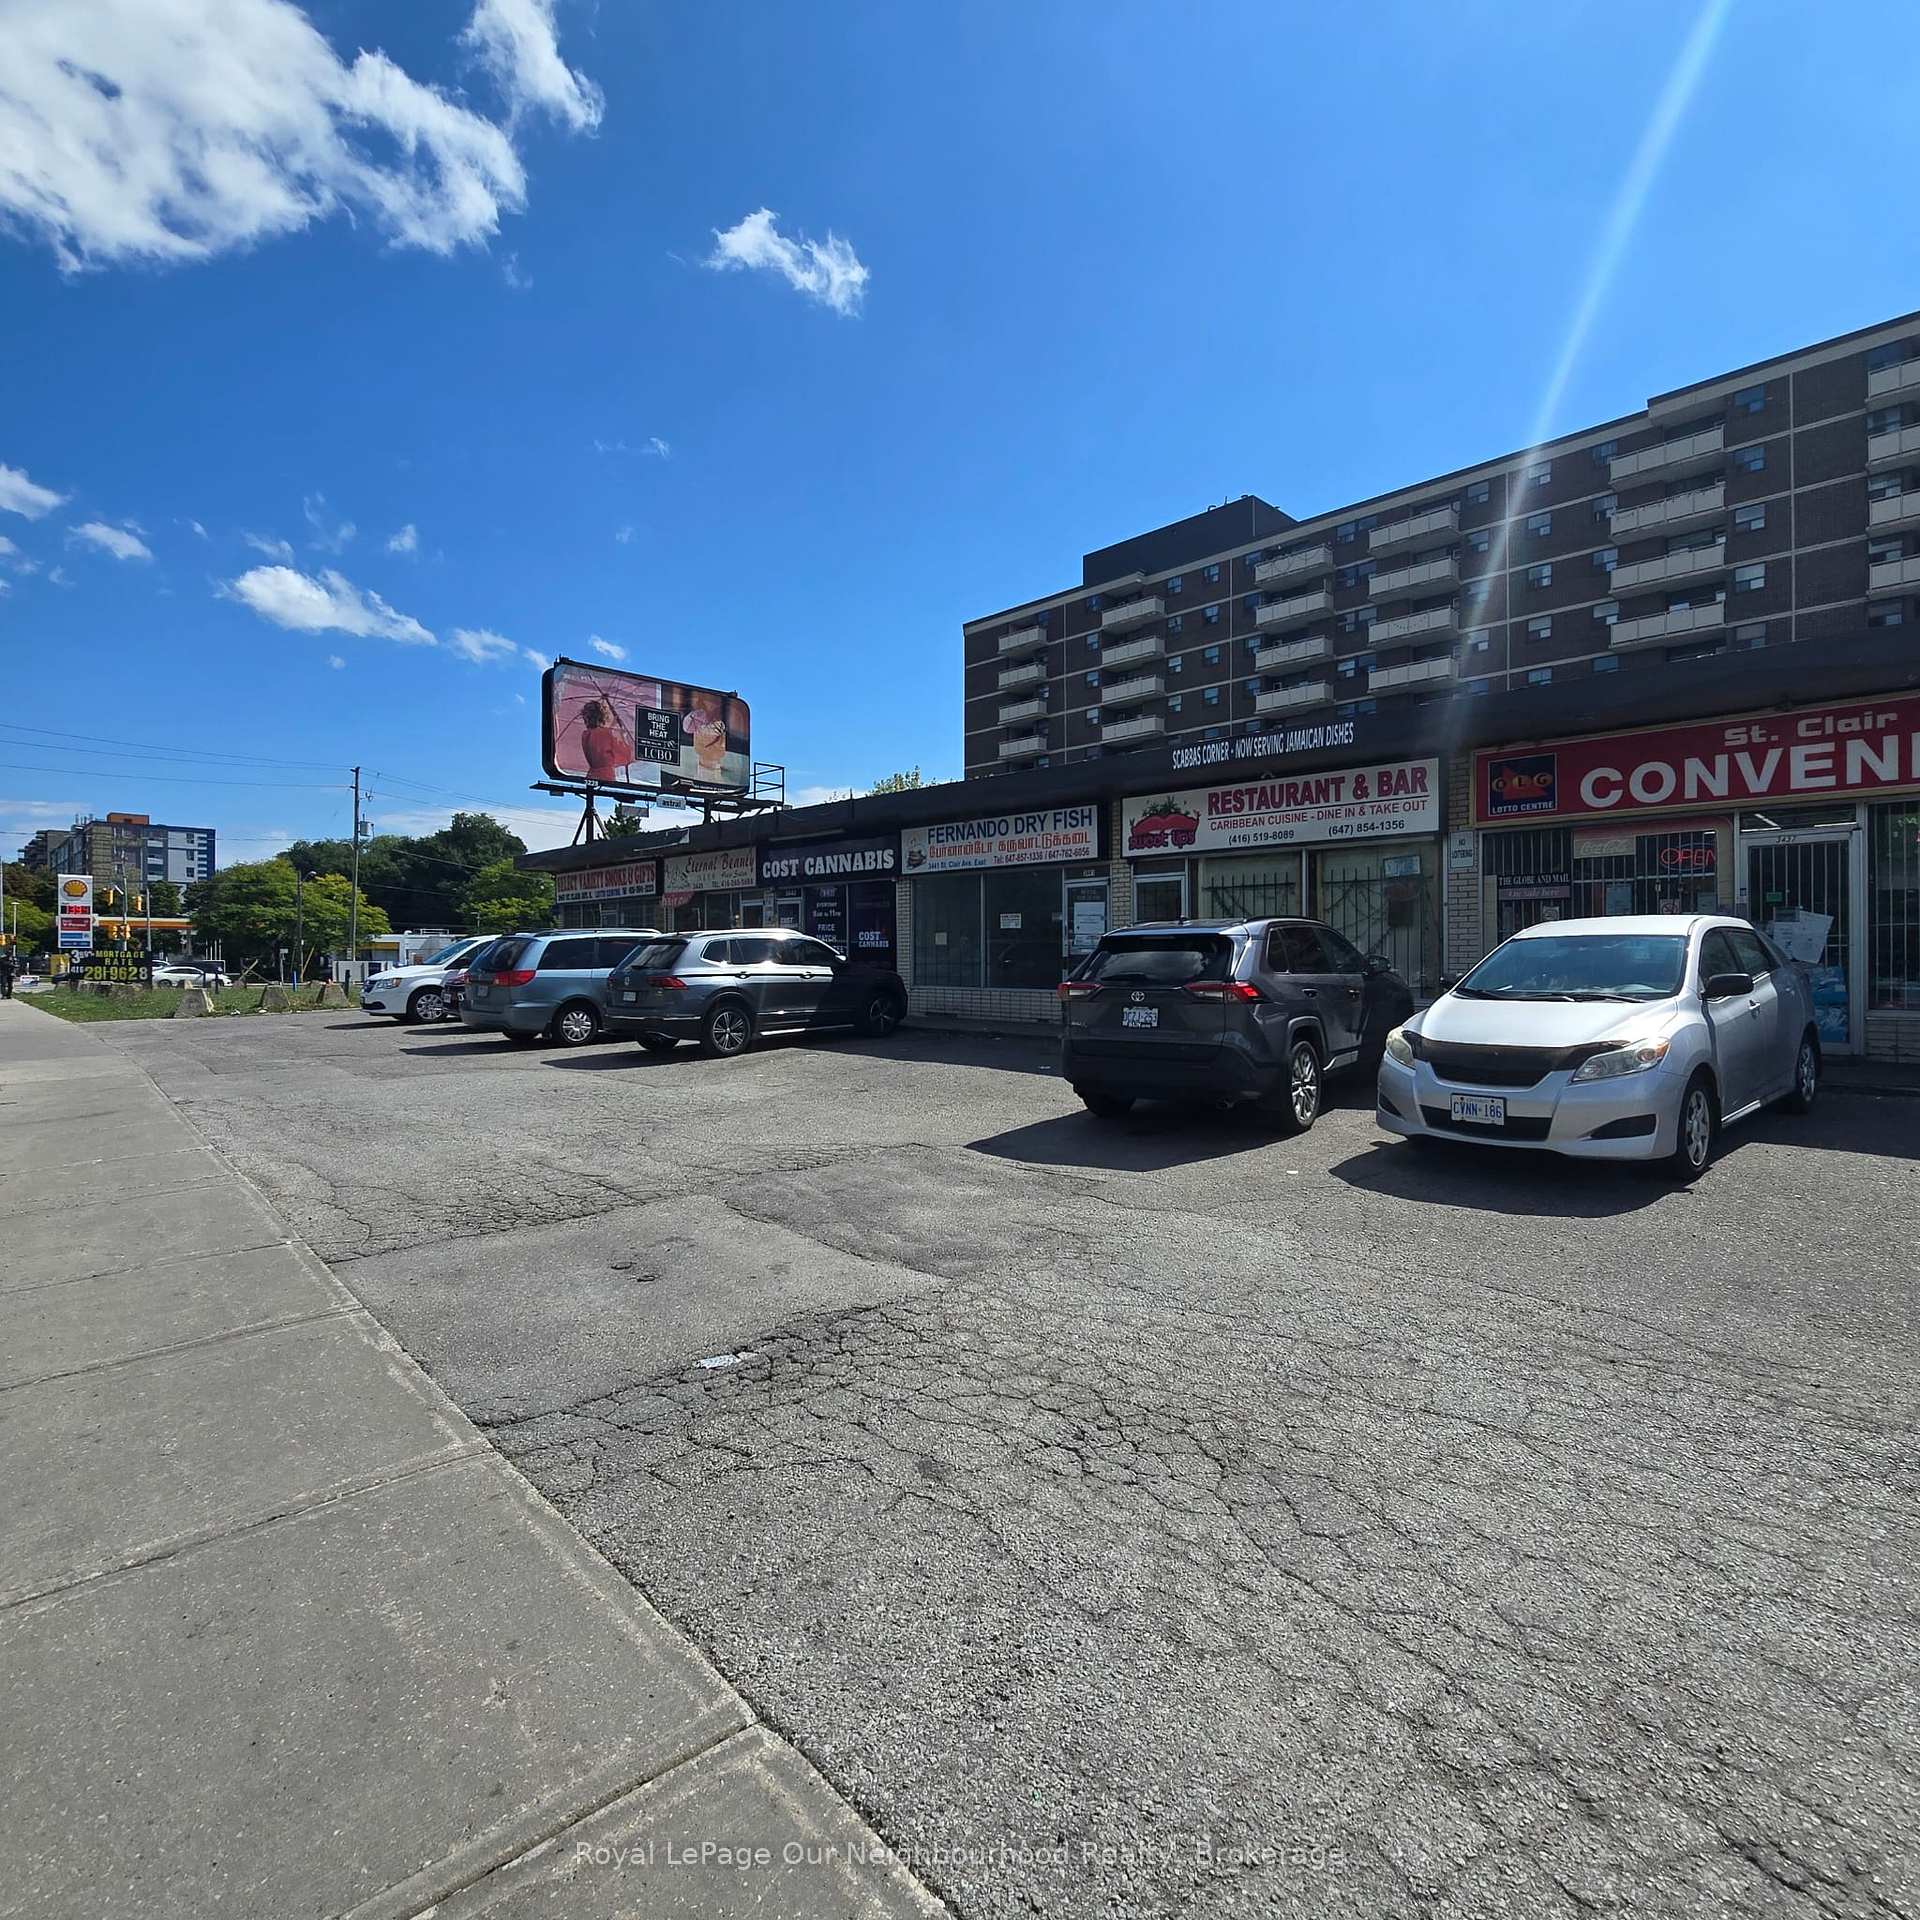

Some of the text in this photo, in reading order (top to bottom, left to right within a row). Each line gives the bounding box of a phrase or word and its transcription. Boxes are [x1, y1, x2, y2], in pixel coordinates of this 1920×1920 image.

[648, 712, 670, 724] BRING
[651, 721, 667, 731] THE
[1724, 710, 1899, 747] St. Clair
[649, 729, 668, 739] HEAT
[1202, 741, 1229, 764] CORNER
[1235, 736, 1254, 759] NOW
[1254, 732, 1285, 757] SERVING
[1285, 727, 1324, 752] JAMAICAN
[1325, 722, 1354, 746] DISHES
[644, 746, 672, 761] LCBO
[1208, 766, 1428, 816] RESTAURANT & BAR
[1492, 801, 1553, 814] LOTTO CENTRE
[1210, 815, 1266, 831] CARIBBEAN
[1268, 812, 1308, 828] CUISINE
[1317, 809, 1342, 821] DINE
[1344, 807, 1356, 818] IN
[1358, 806, 1367, 817] &
[1370, 802, 1400, 815] TAKE
[1403, 800, 1428, 812] OUT
[927, 808, 1092, 844] FERNANDO DRY FISH
[1328, 819, 1405, 837] (647) 854-1356
[1228, 833, 1250, 846] (416)
[1458, 838, 1466, 846] NO
[1660, 848, 1716, 865] OPEN
[762, 849, 894, 878] COST CANNABIS
[1498, 872, 1570, 887] THE GLOBE AND MAIL
[817, 924, 836, 932] PRICE
[858, 931, 881, 941] COST
[858, 940, 889, 948] CANNABIS
[95, 950, 145, 958] MORTGAGE
[104, 957, 134, 966] RATE
[84, 966, 148, 980] 281-9628
